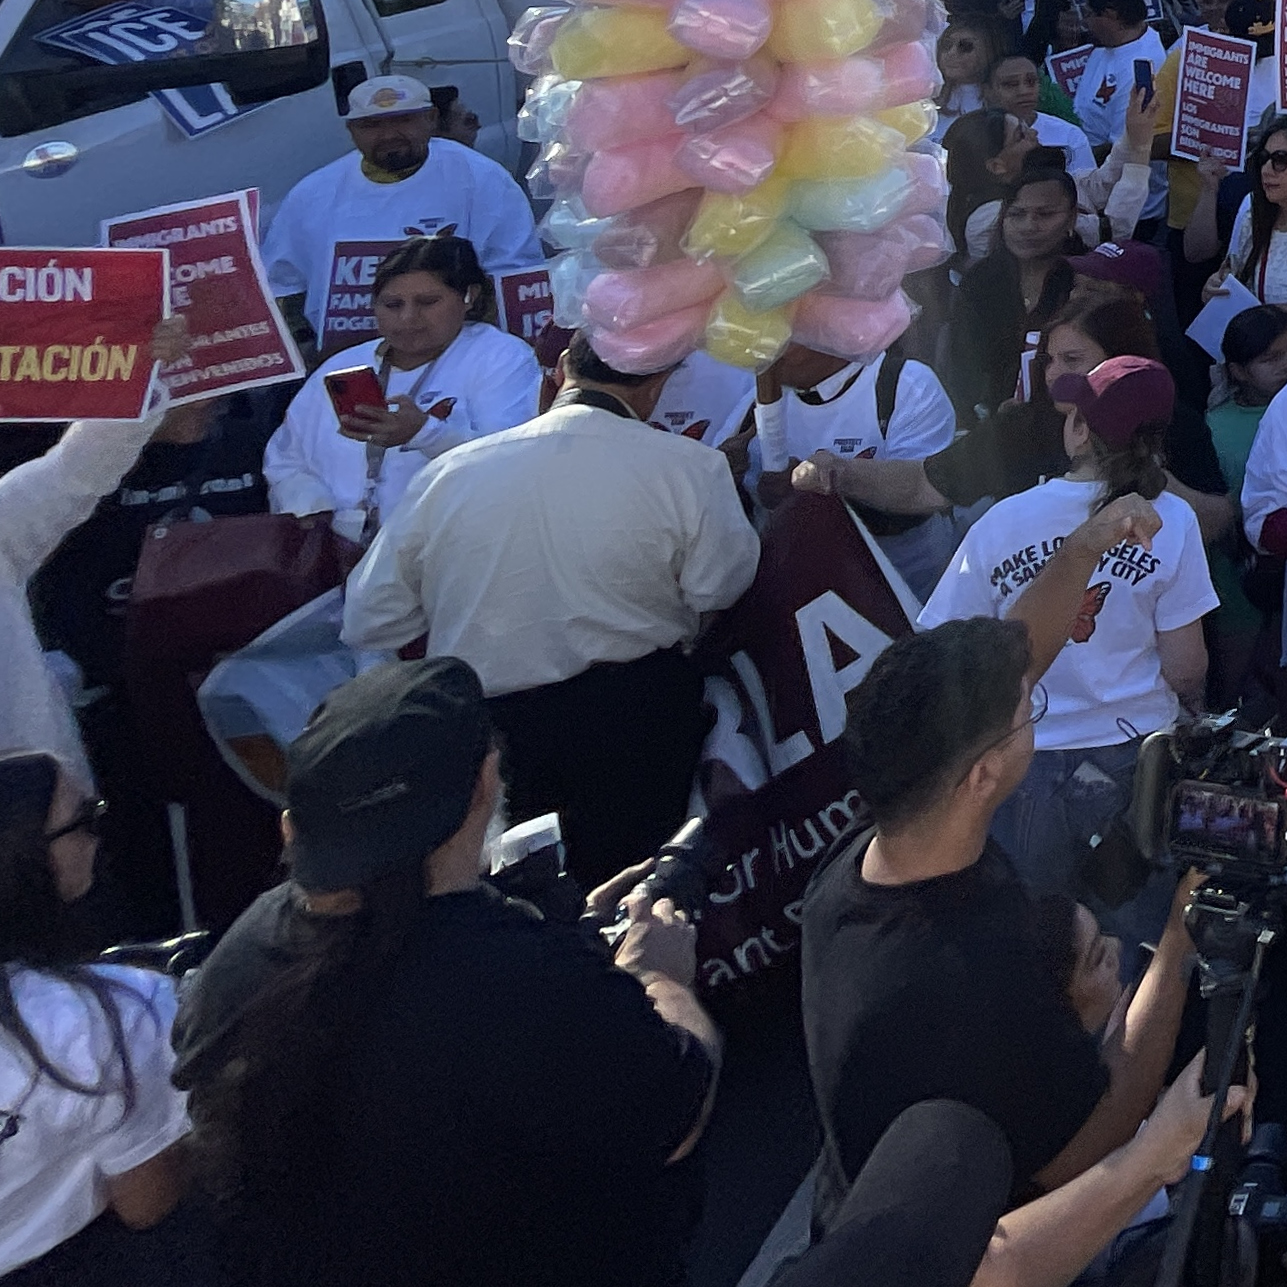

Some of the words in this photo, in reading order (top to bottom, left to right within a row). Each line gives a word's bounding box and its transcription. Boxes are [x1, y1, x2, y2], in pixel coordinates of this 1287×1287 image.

[87, 12, 205, 61] ICE
[1186, 53, 1208, 70] ARE
[1188, 41, 1250, 65] IMMIGRANTS
[1183, 78, 1215, 100] HERE
[1185, 66, 1242, 90] WELCOME
[1182, 102, 1198, 114] LOS
[1180, 124, 1200, 139] SON
[0, 258, 94, 302] CIÓN
[335, 255, 387, 286] KE
[327, 315, 379, 331] TOGE
[0, 335, 138, 382] TACIÓN
[990, 544, 1039, 588] MAKE
[1042, 535, 1066, 558] LO
[1106, 541, 1162, 575] GELES
[1111, 559, 1149, 587] CITY
[708, 847, 760, 904] or
[768, 787, 867, 875] Hum
